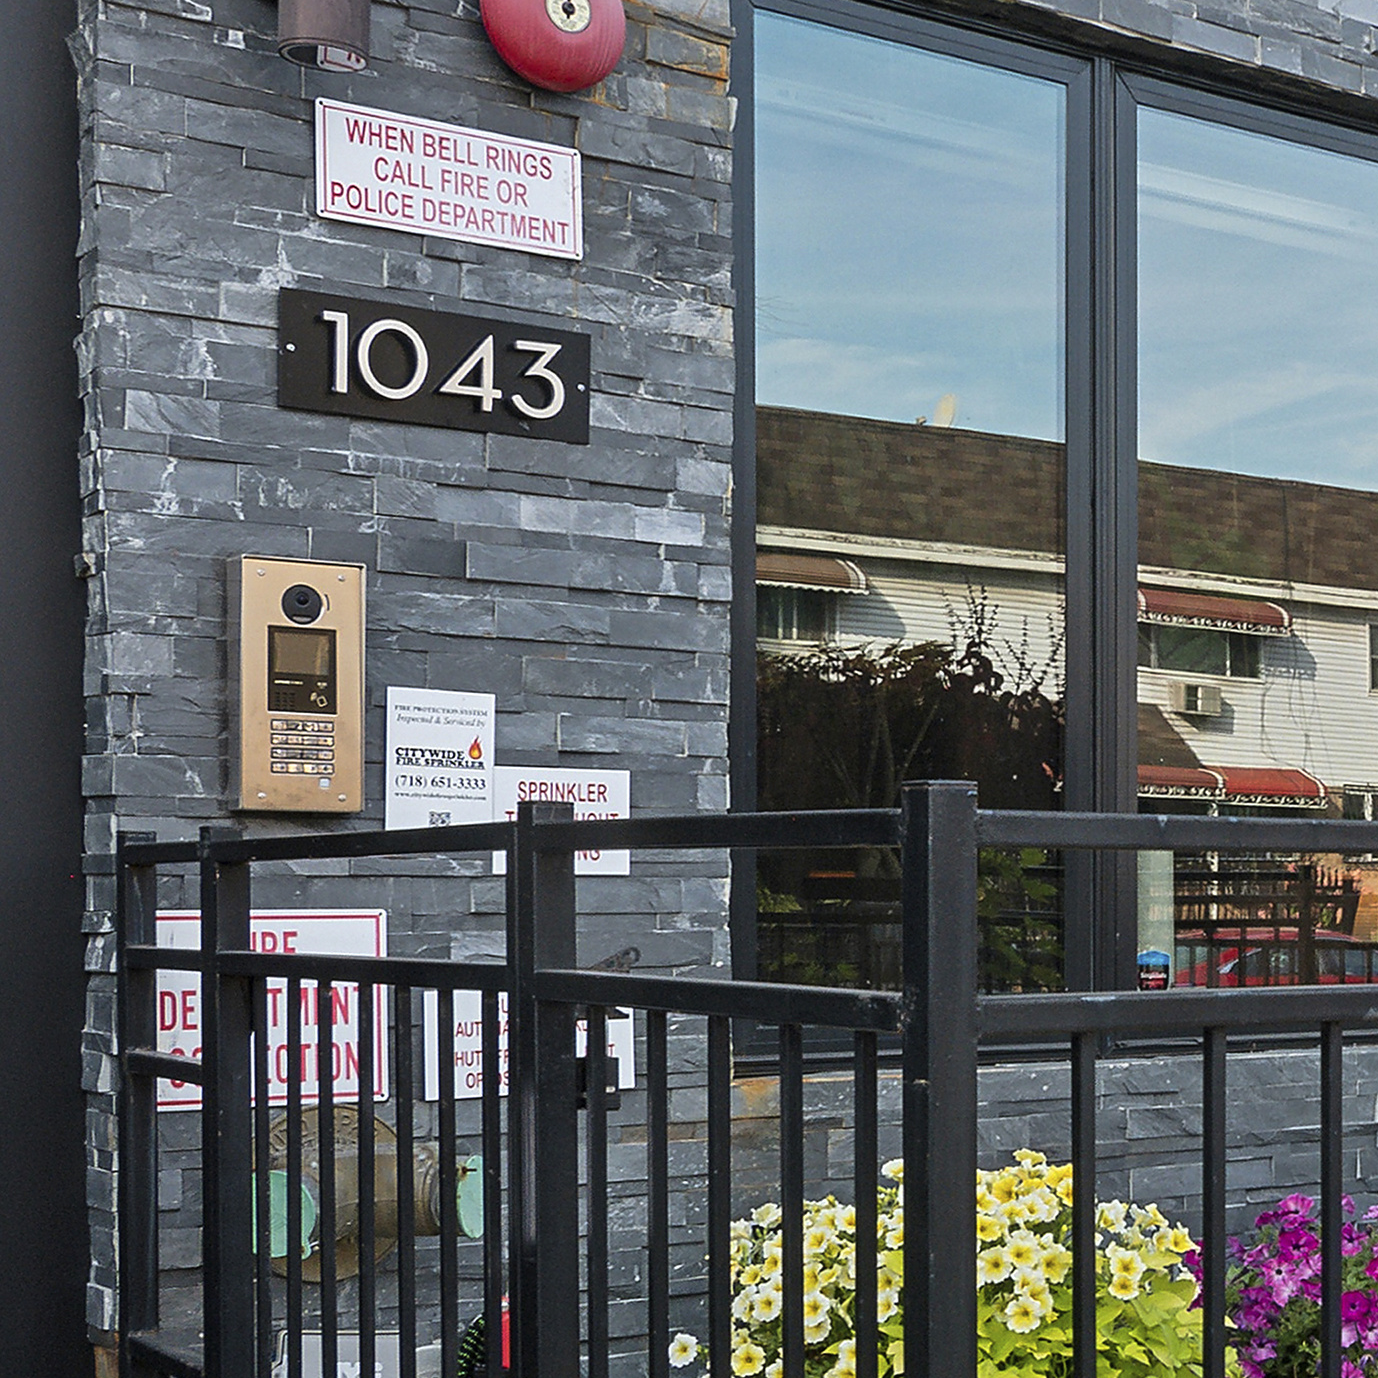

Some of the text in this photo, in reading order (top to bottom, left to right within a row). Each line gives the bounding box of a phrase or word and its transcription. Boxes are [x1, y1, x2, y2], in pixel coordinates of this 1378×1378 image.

[346, 117, 553, 180] WHEN BELL RINGS
[374, 157, 529, 208] CALL FIRE OR
[330, 181, 570, 245] POLICE DEPARTMENT
[322, 310, 566, 420] 1043
[413, 706, 459, 714] PROTECTION
[460, 709, 488, 717] SYSTEM
[395, 747, 466, 761] CITYWIDE
[395, 756, 486, 770] FIRE SPRINKLER
[394, 774, 487, 790] (718) 651-3333
[517, 780, 609, 803] SPRINKLER
